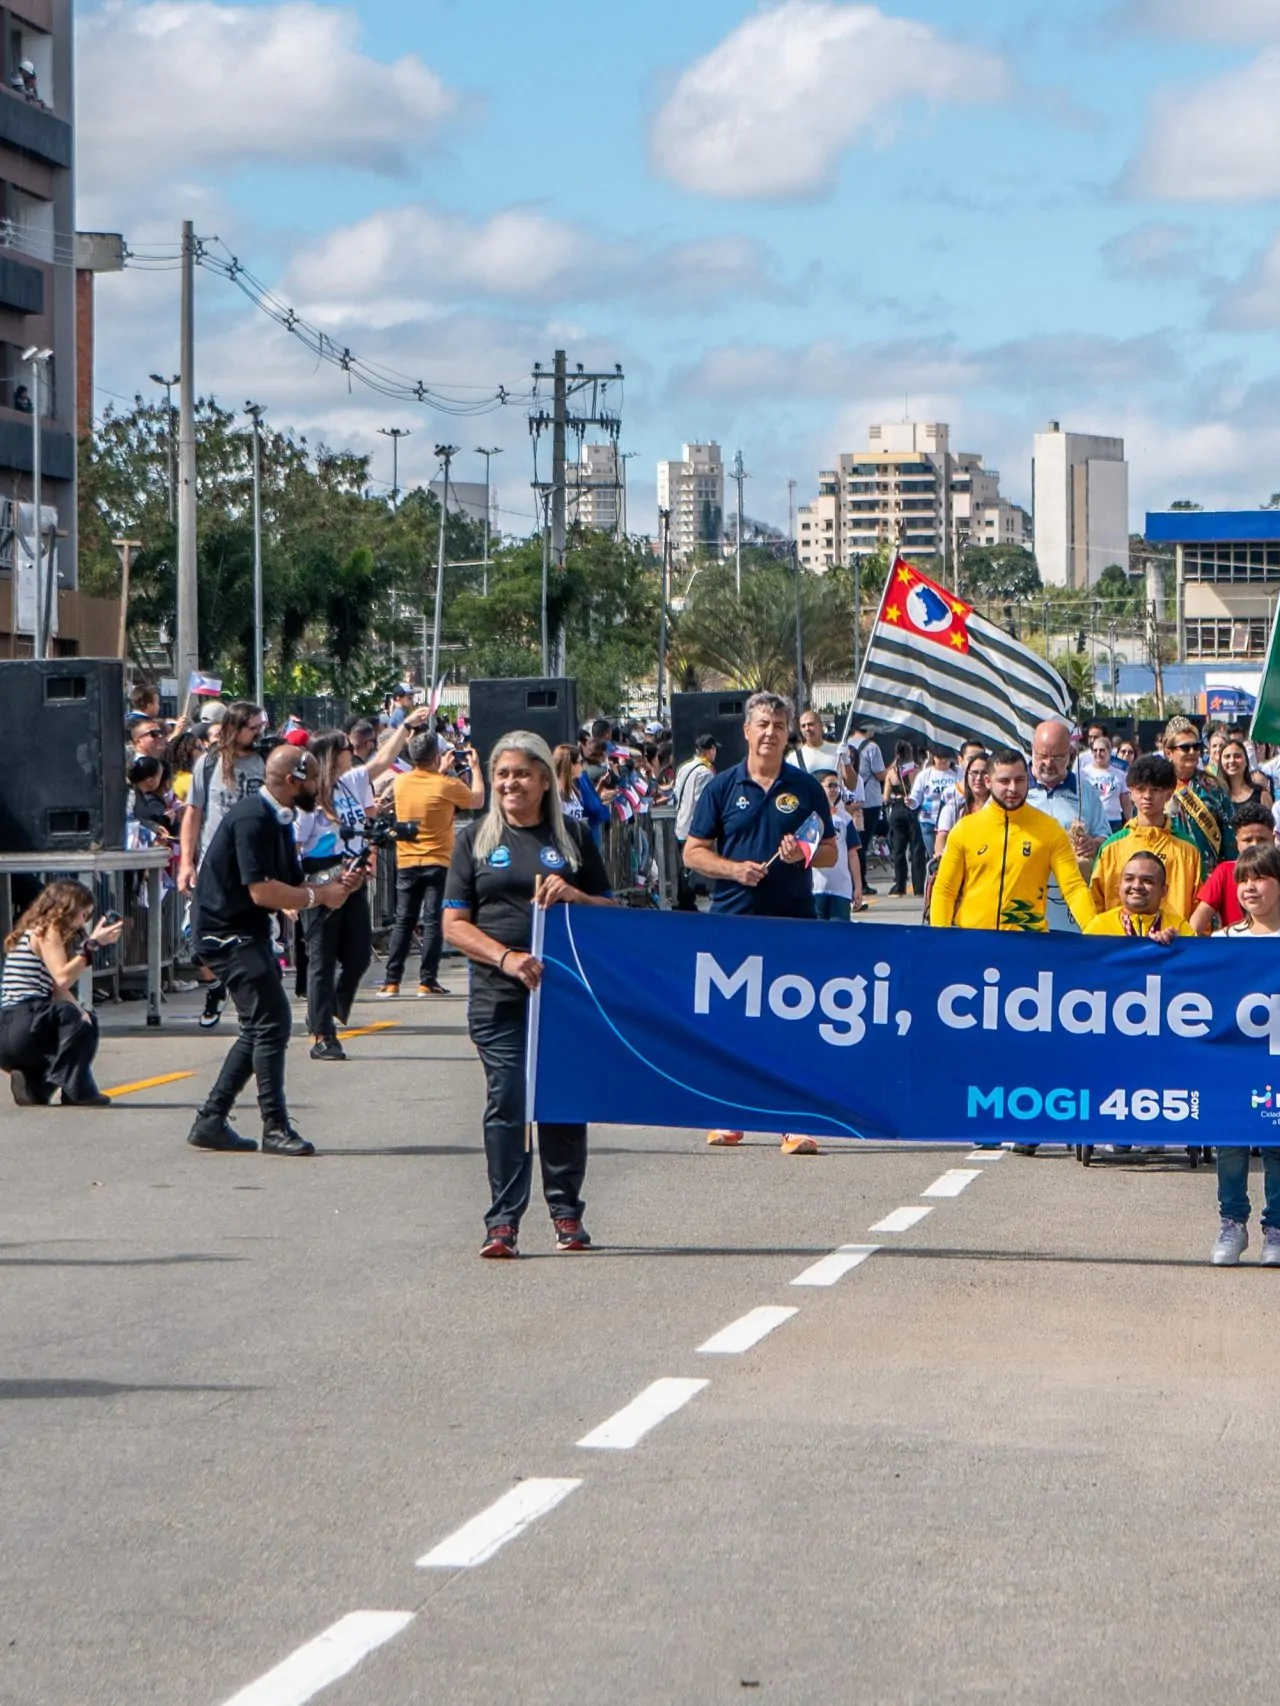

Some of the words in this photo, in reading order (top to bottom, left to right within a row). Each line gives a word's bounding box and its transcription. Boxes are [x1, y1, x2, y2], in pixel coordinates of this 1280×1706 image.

[694, 952, 912, 1046] Mogi,
[937, 967, 1213, 1037] cidade
[967, 1085, 1090, 1120] MOGI
[1099, 1088, 1190, 1121] 465
[1190, 1090, 1200, 1120] ANOS
